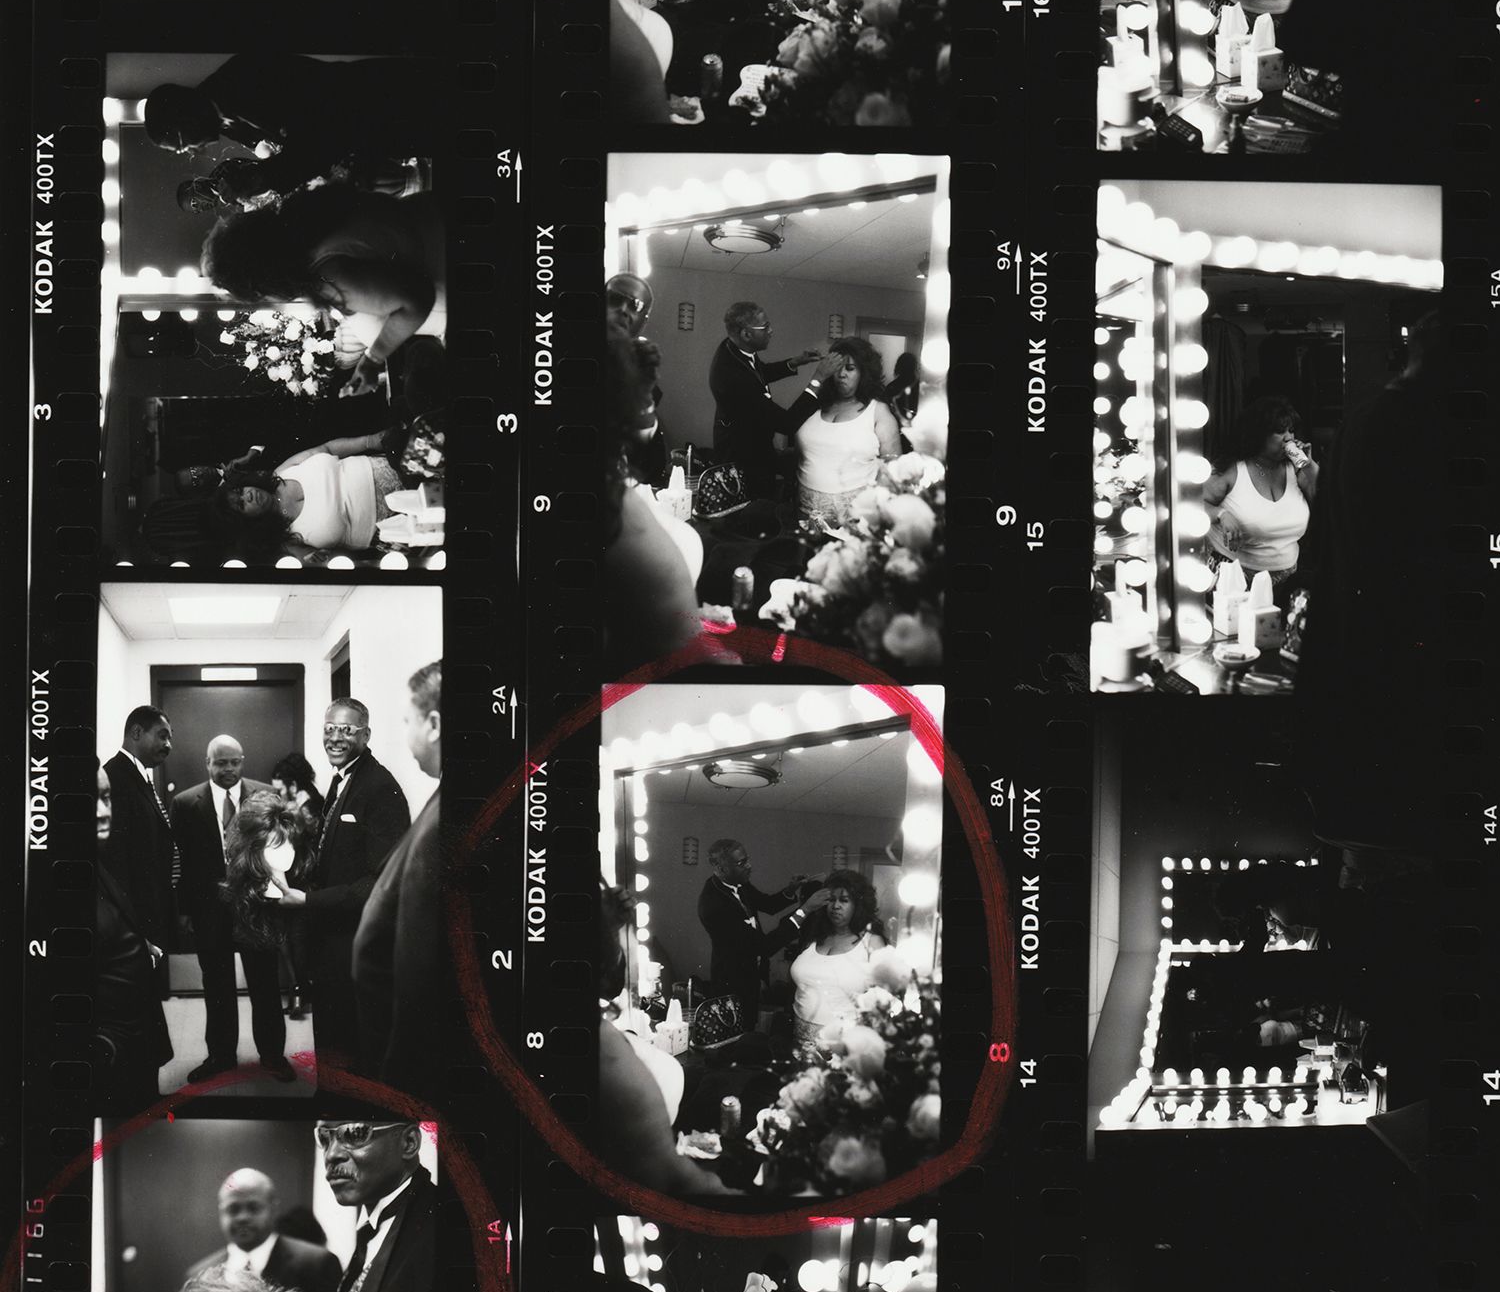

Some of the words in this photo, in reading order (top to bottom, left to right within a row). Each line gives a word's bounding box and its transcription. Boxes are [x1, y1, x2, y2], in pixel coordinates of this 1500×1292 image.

[37, 134, 54, 204] 400TX
[35, 221, 53, 313] KODAK
[537, 225, 553, 295] 400TX
[1030, 252, 1047, 321] 400TX
[535, 312, 553, 405] KODAK
[1028, 339, 1046, 431] KODAK
[497, 414, 517, 433] 3
[534, 495, 550, 512] 9
[996, 506, 1016, 525] 9
[32, 670, 49, 740] 400TX
[493, 686, 505, 714] 2A
[31, 757, 48, 849] KODAK
[530, 762, 547, 831] 400TX
[991, 778, 1003, 806] 8A
[1023, 789, 1040, 858] 400TX
[1484, 806, 1497, 844] 14A
[528, 849, 546, 941] KODAK
[1021, 876, 1039, 969] KODAK
[29, 940, 46, 957] 2
[492, 950, 512, 969] 2
[527, 1032, 544, 1048] 8
[1020, 1059, 1036, 1087] 14
[487, 1218, 501, 1244] 1A
